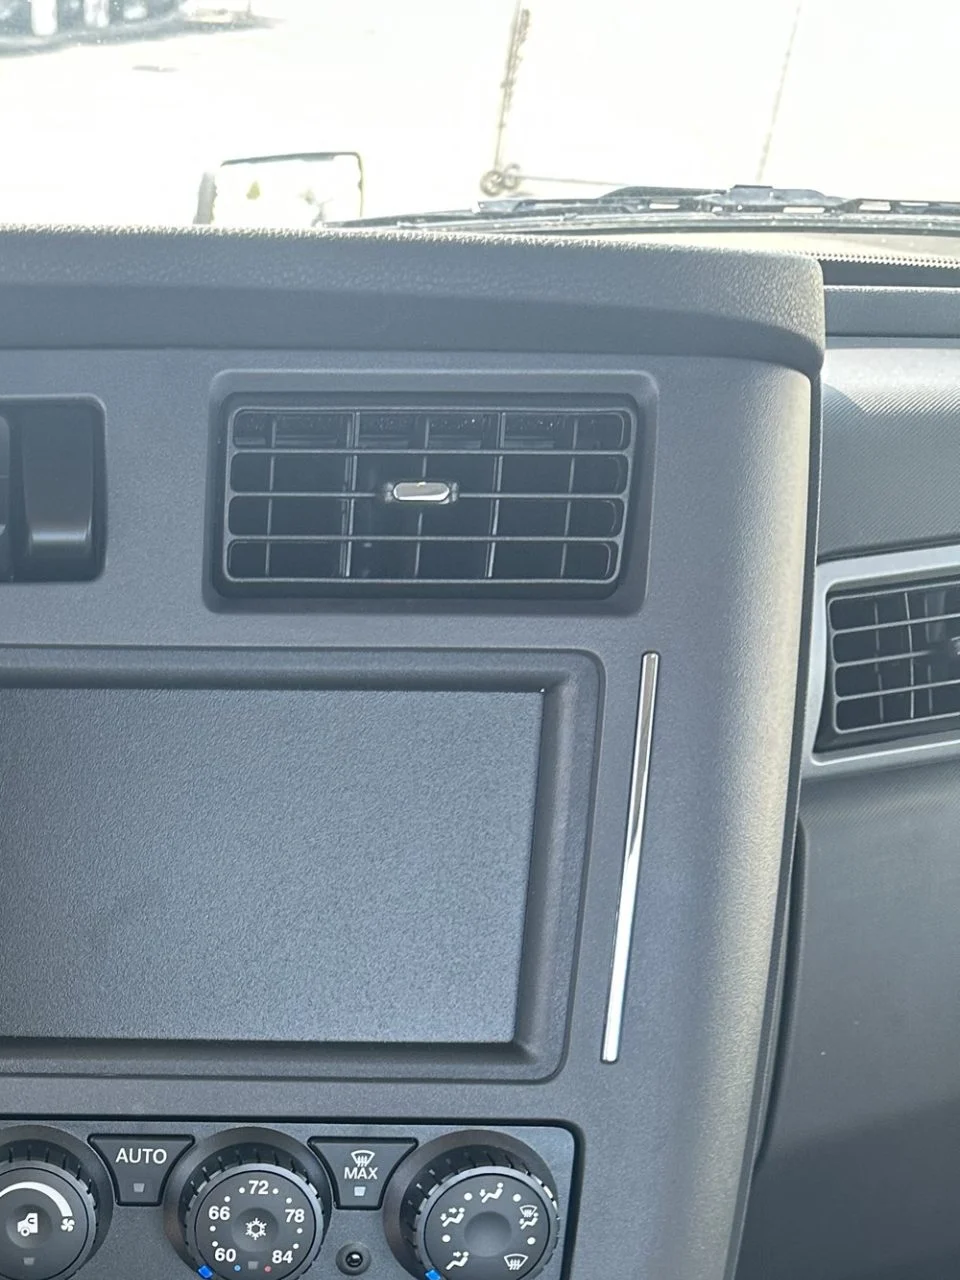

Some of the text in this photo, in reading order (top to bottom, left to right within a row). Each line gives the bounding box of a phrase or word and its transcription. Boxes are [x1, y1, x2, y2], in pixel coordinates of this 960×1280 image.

[115, 1148, 167, 1165] AUTO
[343, 1167, 378, 1180] MAX
[248, 1180, 269, 1195] 72
[208, 1206, 230, 1220] 66
[285, 1209, 305, 1223] 78
[214, 1248, 237, 1262] 60
[272, 1250, 294, 1264] 84
